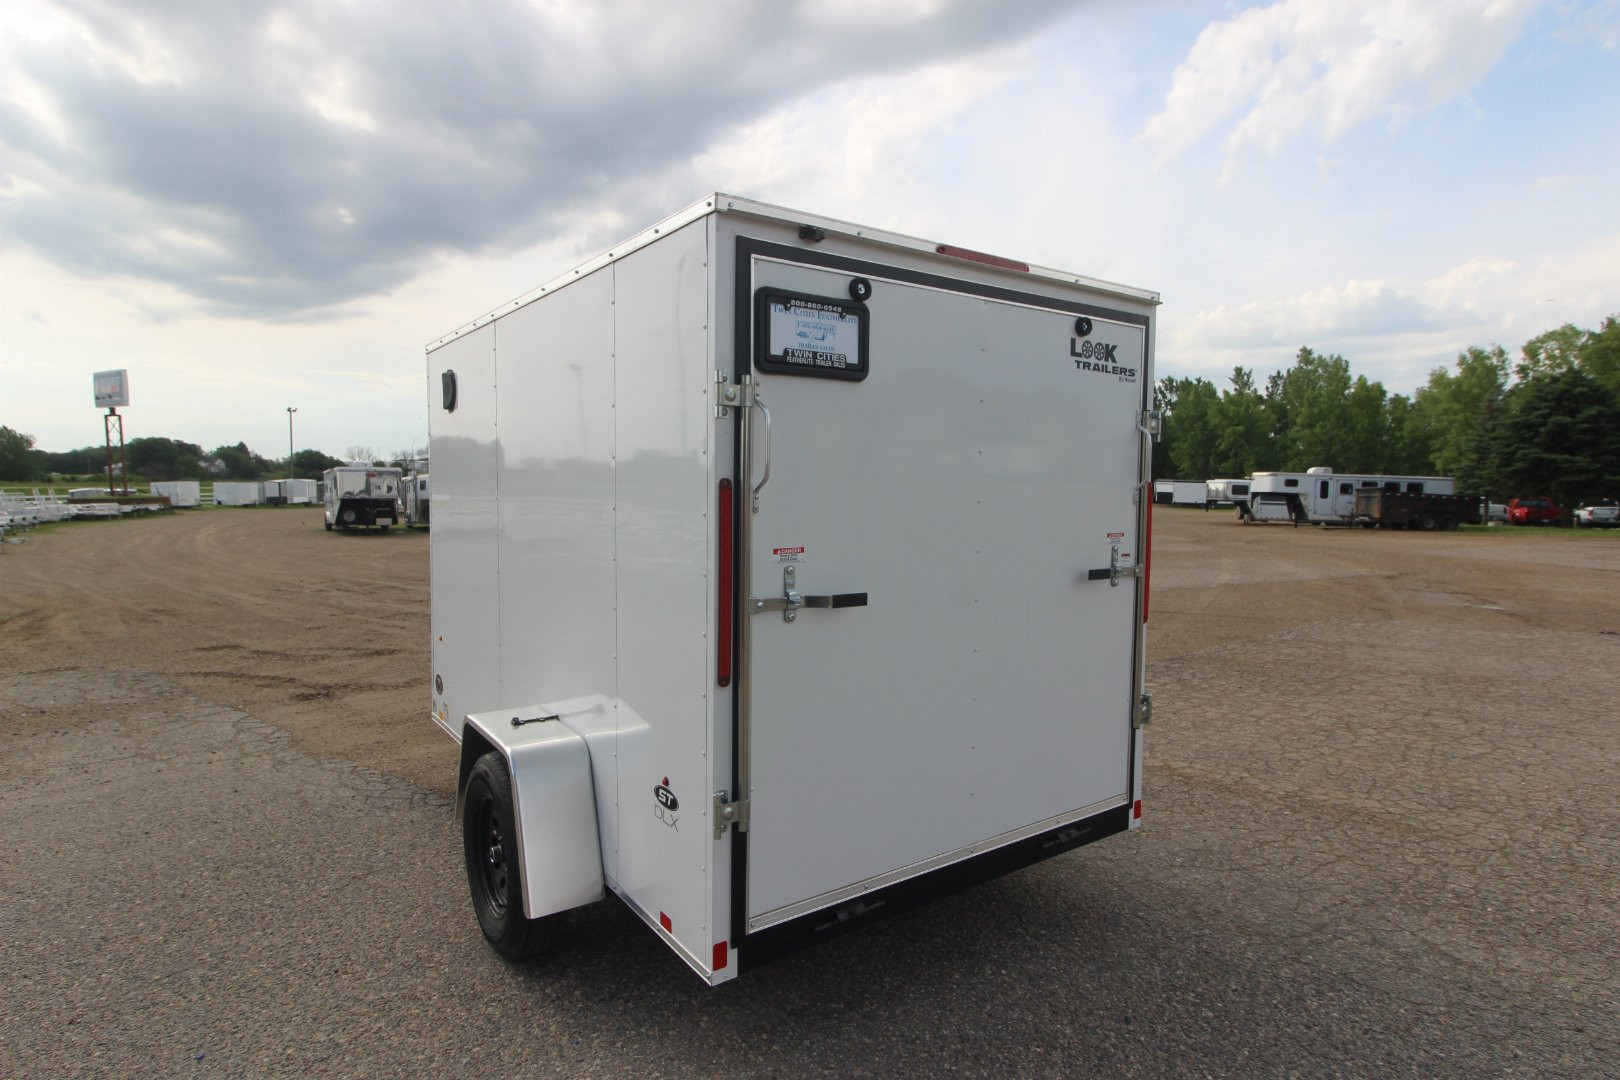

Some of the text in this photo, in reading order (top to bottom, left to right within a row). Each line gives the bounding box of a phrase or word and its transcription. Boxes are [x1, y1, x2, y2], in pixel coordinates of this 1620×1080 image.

[787, 349, 846, 362] TWIN CITIES
[1070, 338, 1117, 363] LOOK
[1075, 360, 1135, 377] TRAILERS
[659, 788, 673, 805] ST
[655, 804, 679, 832] DLX
